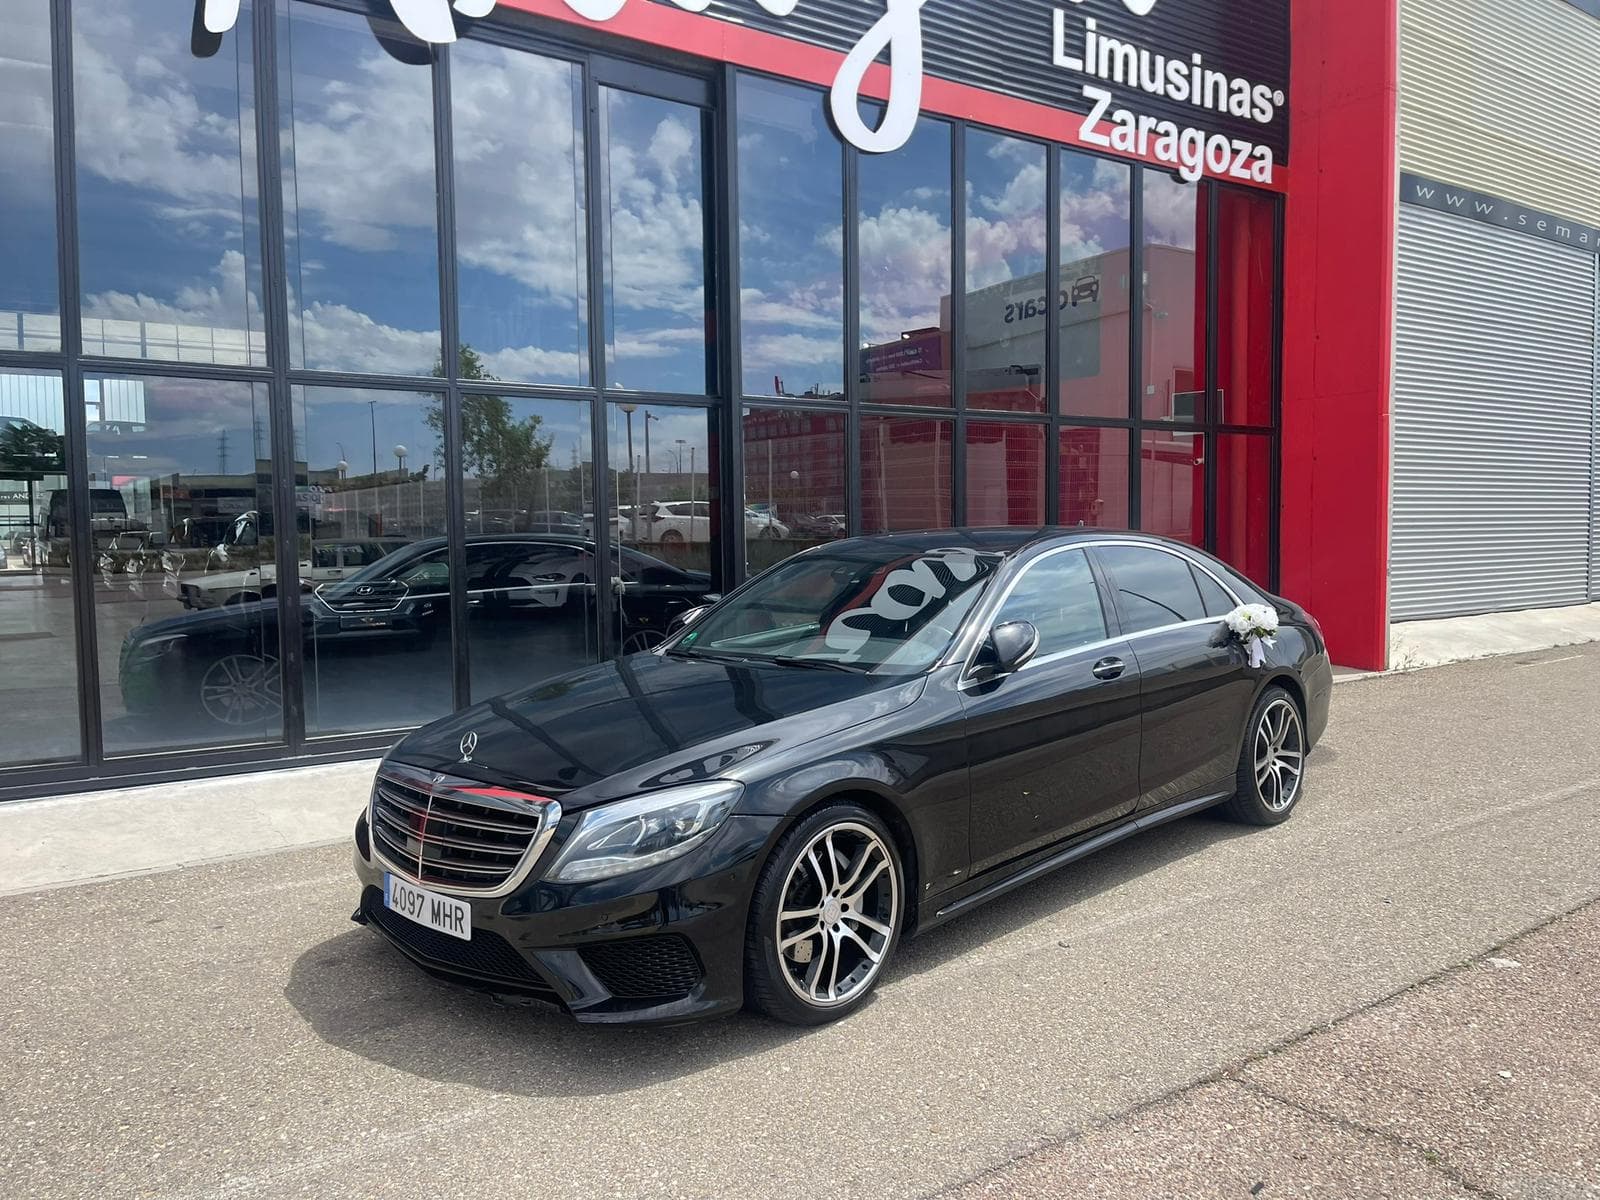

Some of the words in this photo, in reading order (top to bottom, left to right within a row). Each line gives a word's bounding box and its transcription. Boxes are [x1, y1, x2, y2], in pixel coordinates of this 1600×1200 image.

[1079, 85, 1273, 184] Zaragoza
[392, 882, 425, 918] 4097
[431, 898, 464, 934] MHR
